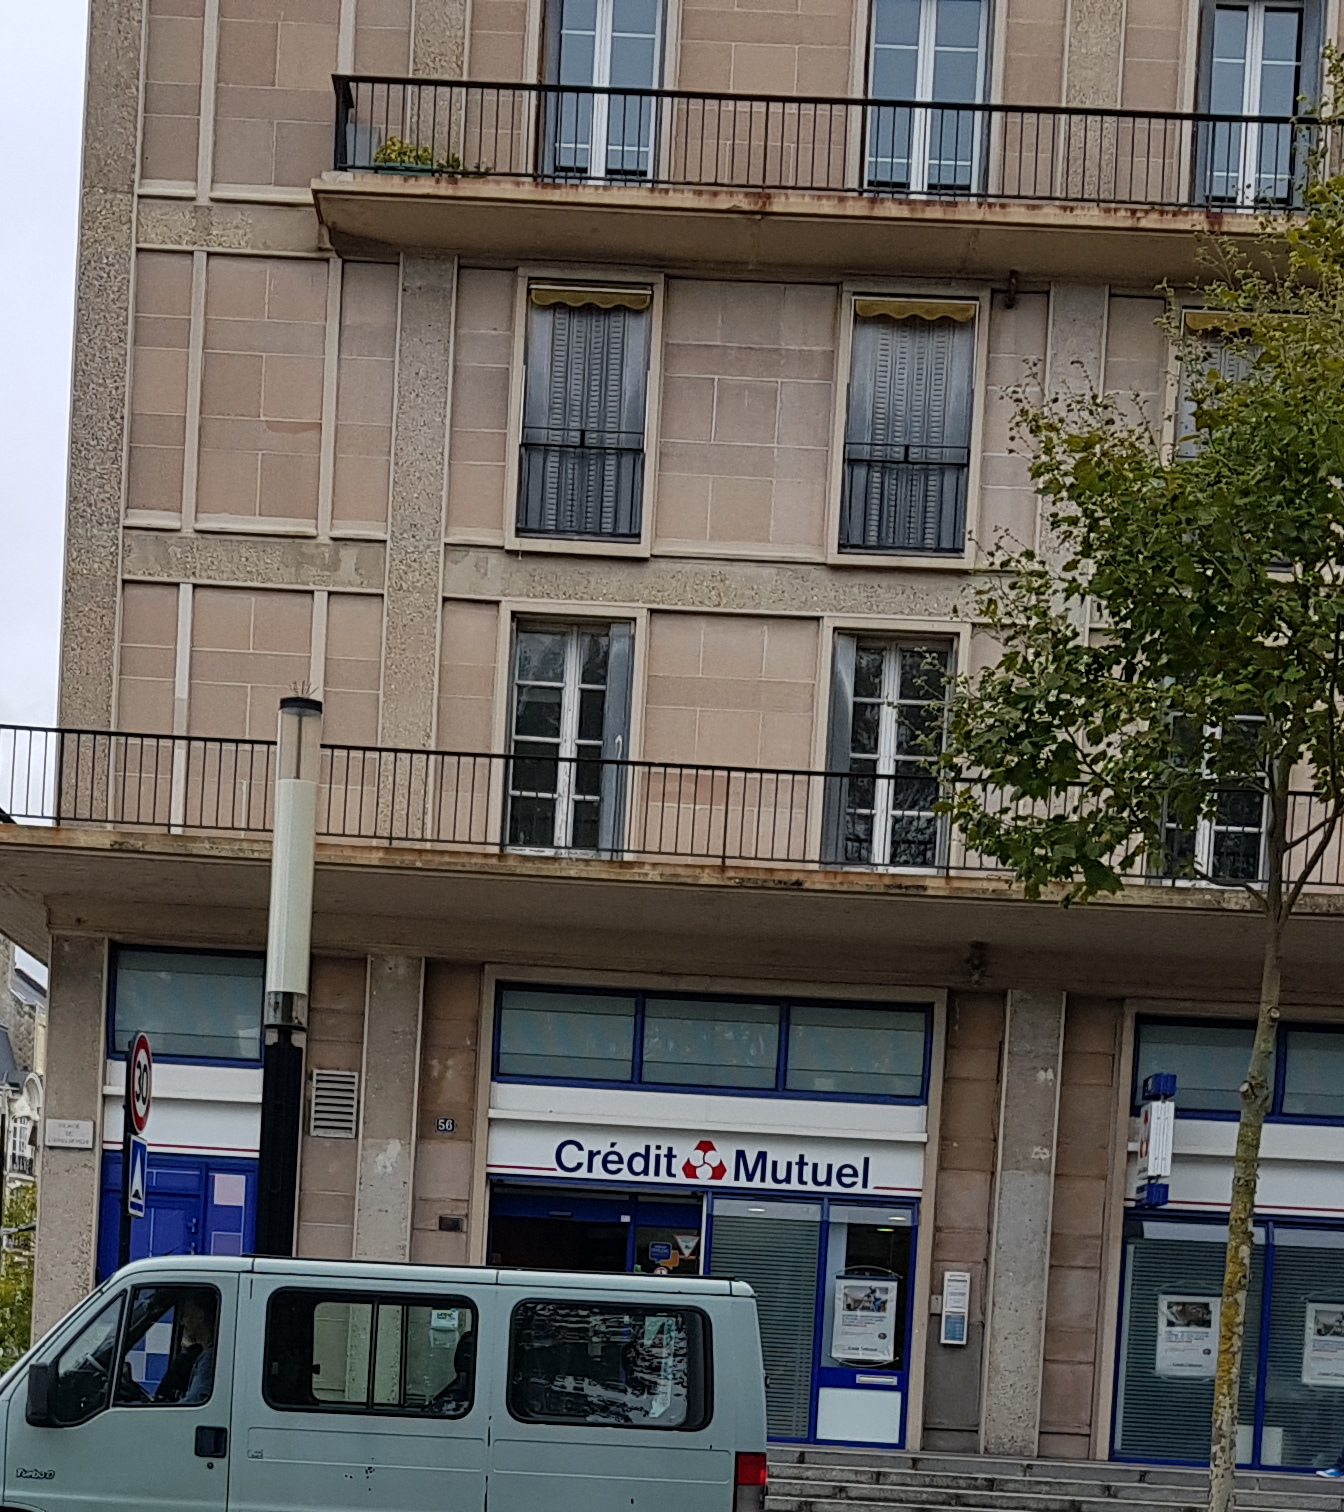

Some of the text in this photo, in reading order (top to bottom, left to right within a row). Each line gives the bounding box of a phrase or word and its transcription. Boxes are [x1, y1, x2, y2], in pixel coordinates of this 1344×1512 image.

[136, 1060, 149, 1106] 30
[438, 1119, 453, 1131] 56
[554, 1139, 871, 1189] Crédit Mutuel
[16, 1468, 45, 1479] Turbo
